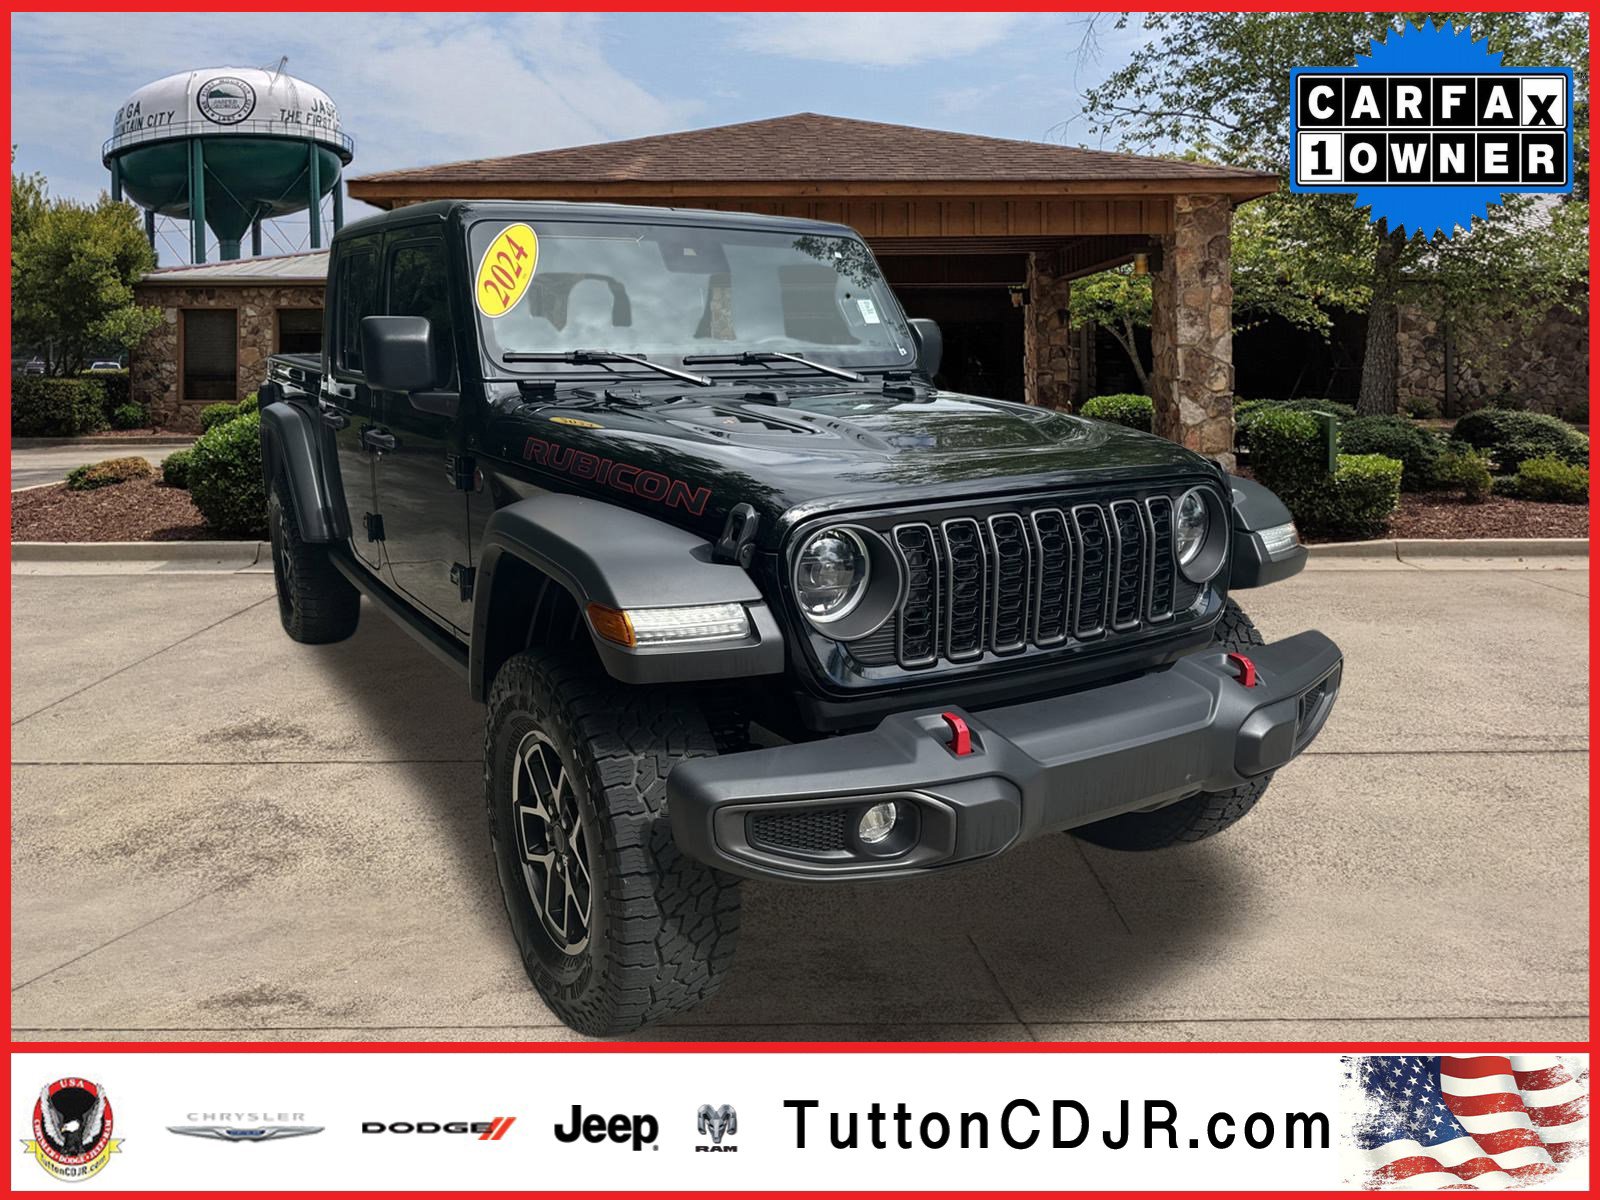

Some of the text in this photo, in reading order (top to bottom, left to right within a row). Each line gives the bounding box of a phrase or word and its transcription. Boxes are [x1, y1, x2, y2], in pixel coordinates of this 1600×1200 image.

[126, 101, 141, 119] GA
[147, 110, 175, 128] CITY
[280, 109, 302, 124] THE
[306, 113, 332, 130] FIRST
[484, 234, 528, 308] 2024
[522, 437, 712, 515] RUBICON
